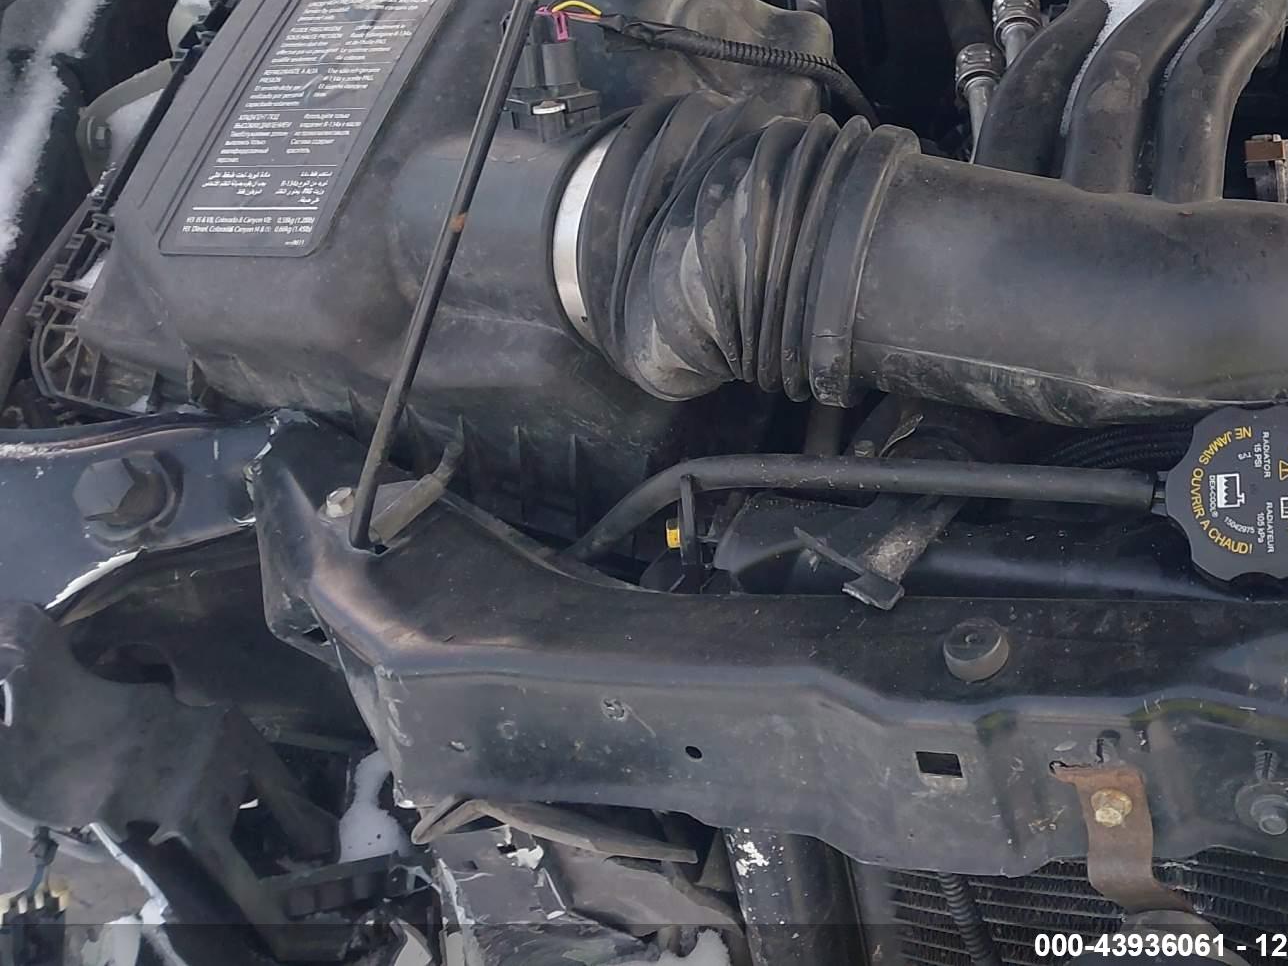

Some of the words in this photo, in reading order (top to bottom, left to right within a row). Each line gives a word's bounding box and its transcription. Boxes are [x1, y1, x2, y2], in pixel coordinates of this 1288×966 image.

[1198, 431, 1232, 465] JAMAIS
[1235, 426, 1252, 440] NE
[1254, 453, 1262, 468] PSI
[1263, 431, 1271, 478] RADIATOR
[1190, 467, 1205, 519] OUVRIR
[1208, 527, 1253, 554] CHAUD!
[1256, 527, 1265, 543] kPa
[1265, 501, 1275, 553] RADIATEUR
